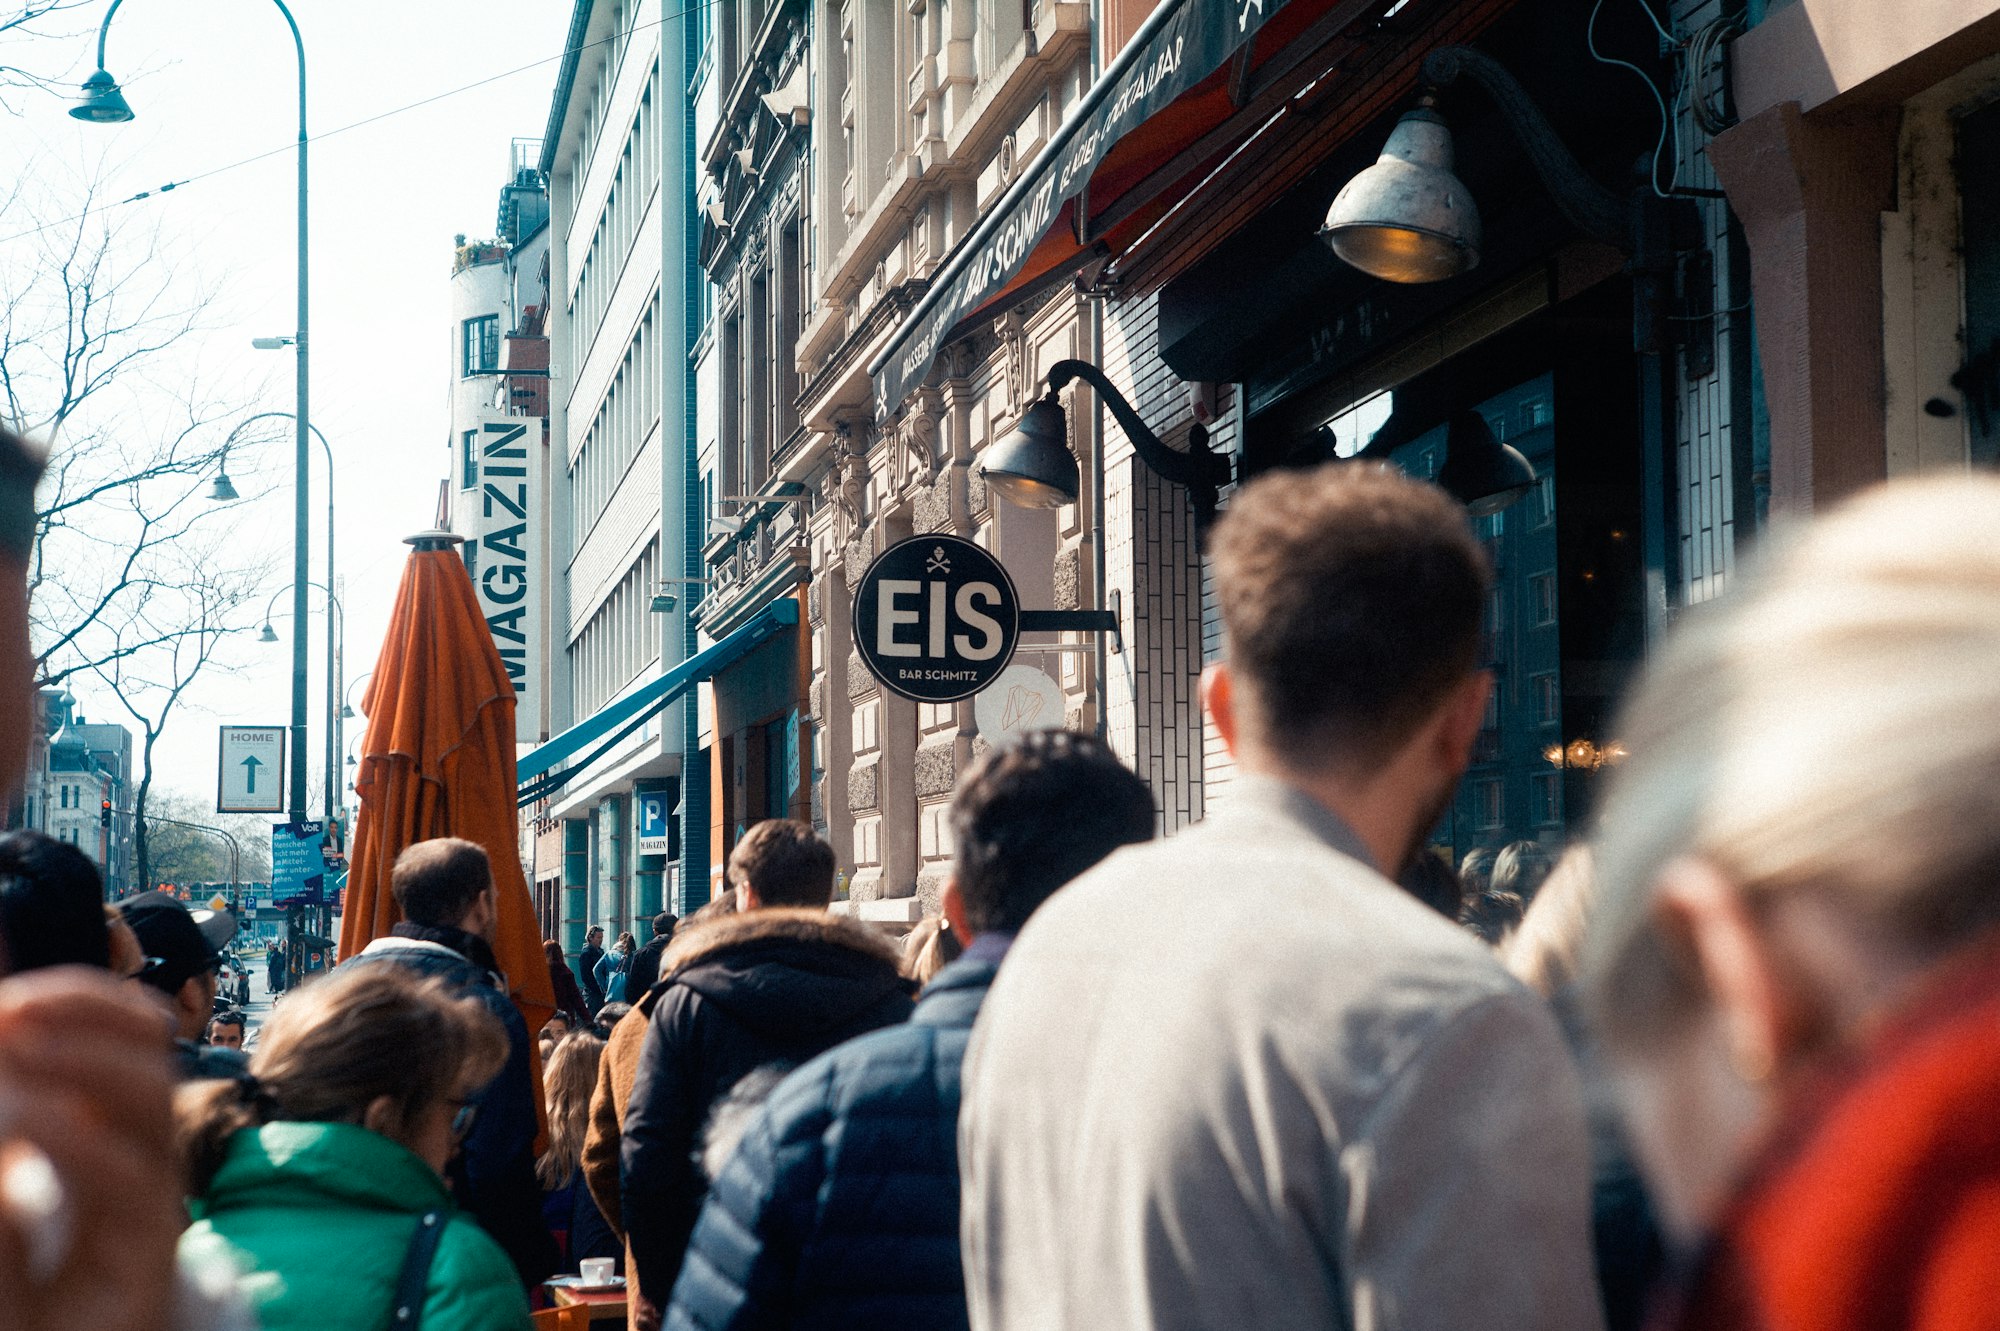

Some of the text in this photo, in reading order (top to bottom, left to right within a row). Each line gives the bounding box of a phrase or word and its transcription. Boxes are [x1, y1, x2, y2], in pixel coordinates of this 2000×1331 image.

[1100, 35, 1183, 141] COCKTAILBAR
[960, 171, 1056, 309] BAR SCHMITZ
[877, 579, 1004, 661] EIS
[899, 669, 978, 682] BAR SCHMITZ
[231, 733, 274, 742] HOME
[645, 800, 661, 831] P
[301, 823, 320, 832] Volt
[640, 840, 667, 850] MAGAZIN
[290, 848, 310, 856] mehr
[247, 897, 255, 908] P
